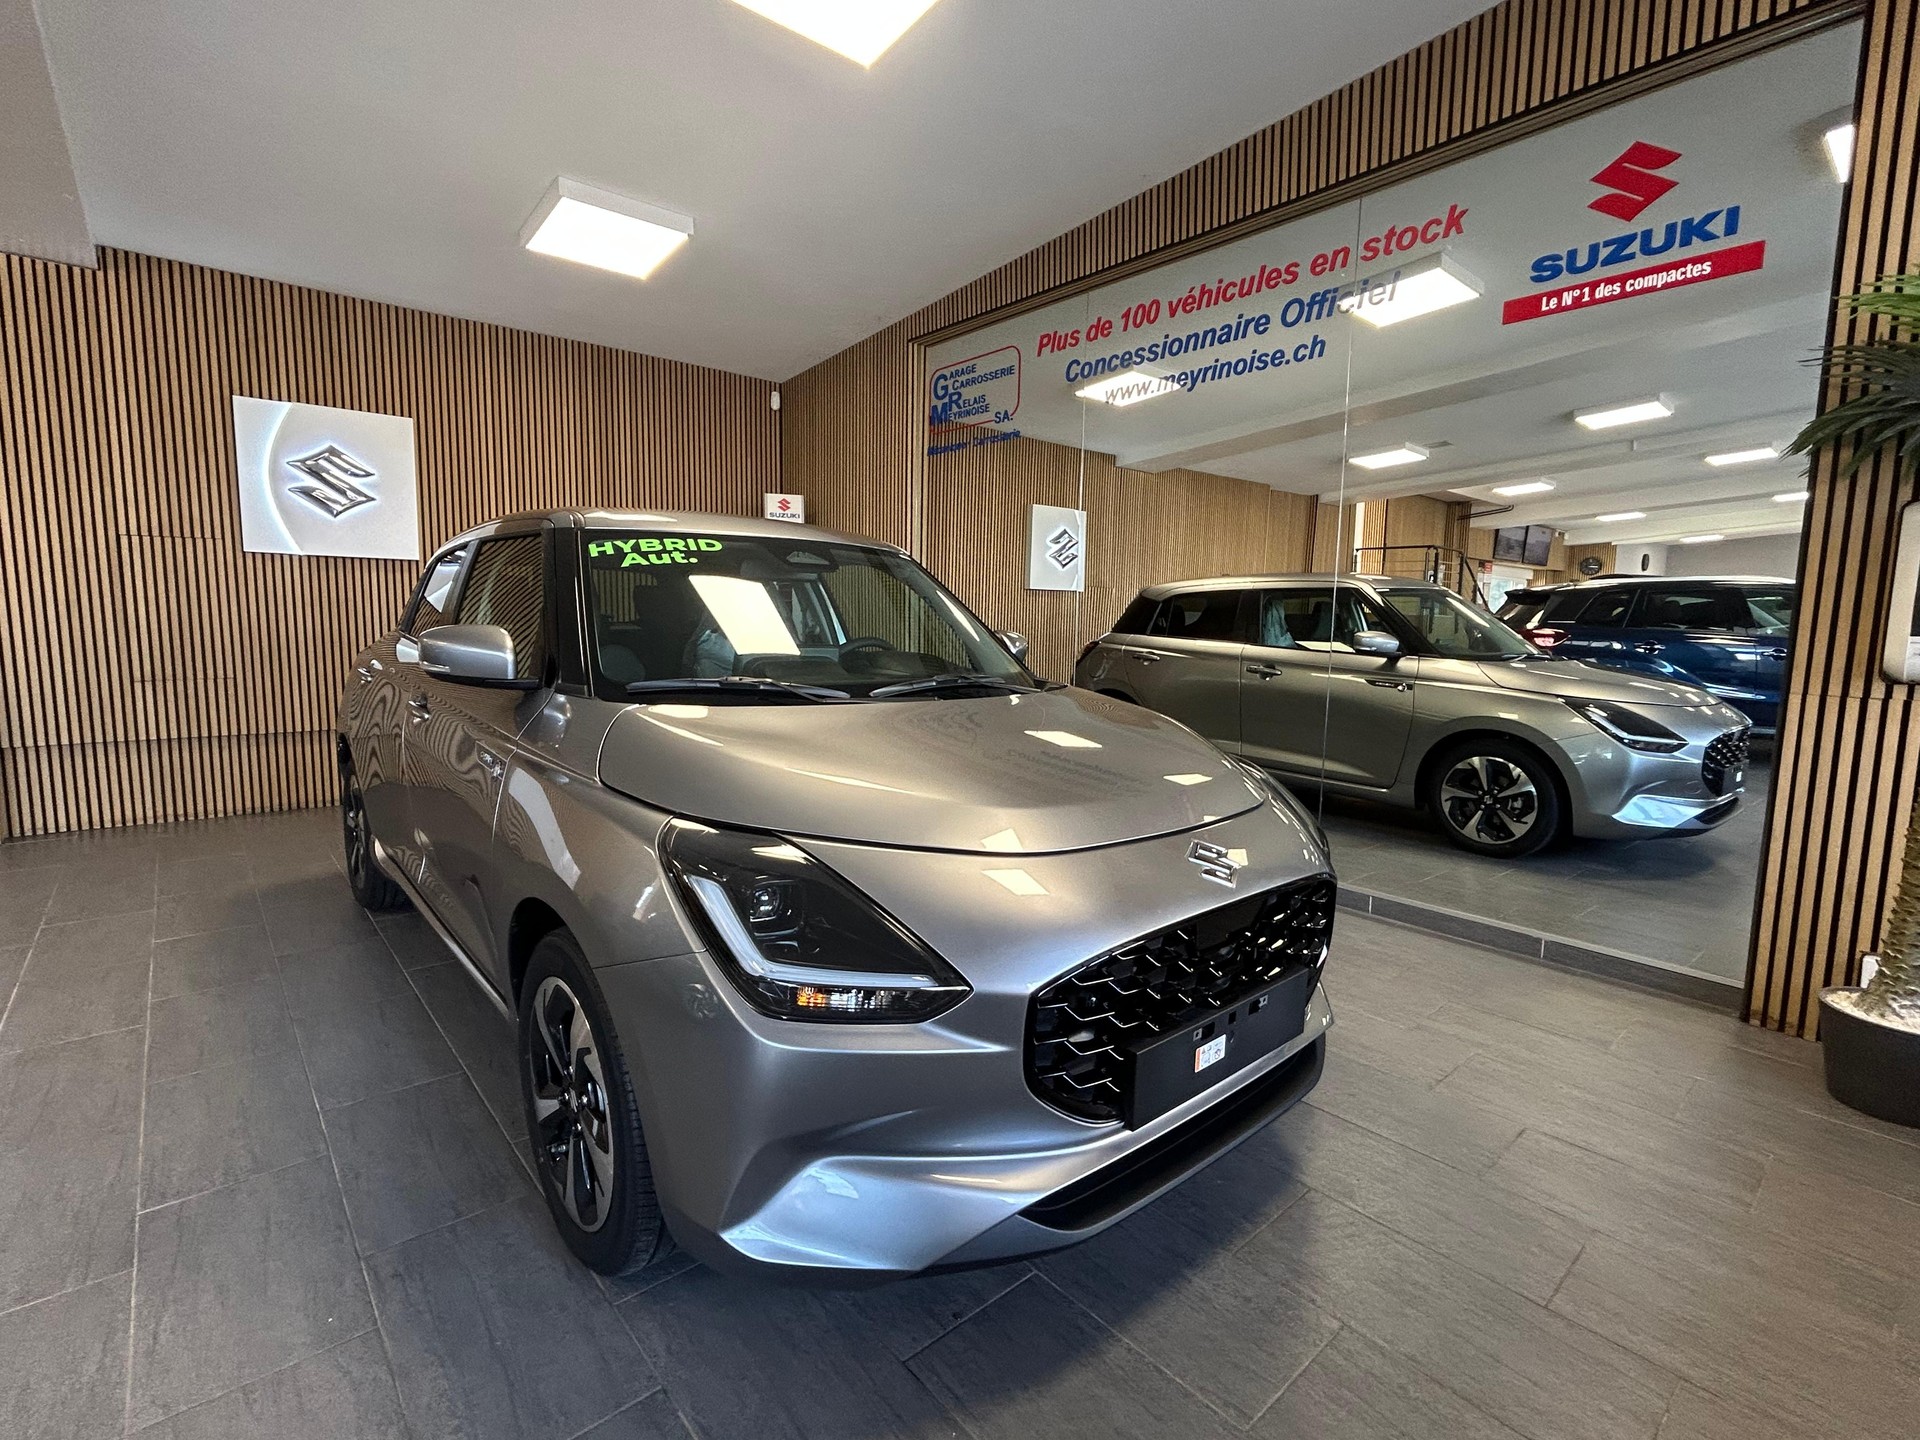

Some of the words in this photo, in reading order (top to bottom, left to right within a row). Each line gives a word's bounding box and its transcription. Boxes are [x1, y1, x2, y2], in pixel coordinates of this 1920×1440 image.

[1529, 205, 1741, 283] SUZUKI
[1037, 329, 1080, 357] Plus
[1085, 316, 1113, 342] de
[1121, 298, 1161, 332] 100
[1167, 261, 1300, 318] véhicules
[1309, 245, 1351, 276] en
[1360, 203, 1469, 262] stock
[1541, 296, 1557, 311] Le
[1561, 286, 1590, 306] N°1
[1595, 282, 1621, 299] des
[1625, 261, 1712, 292] compactes
[1065, 312, 1271, 383] Concessionnaire
[1280, 270, 1402, 328] Officiel
[933, 364, 977, 400] GARAGE
[952, 365, 1016, 390] CARROSSERIE
[1105, 334, 1327, 403] www.meyrinoise.ch
[931, 402, 990, 426] MEYRINOISE
[948, 391, 986, 412] RELAIS
[588, 538, 723, 557] HYBRID
[621, 551, 698, 568] Aut.
